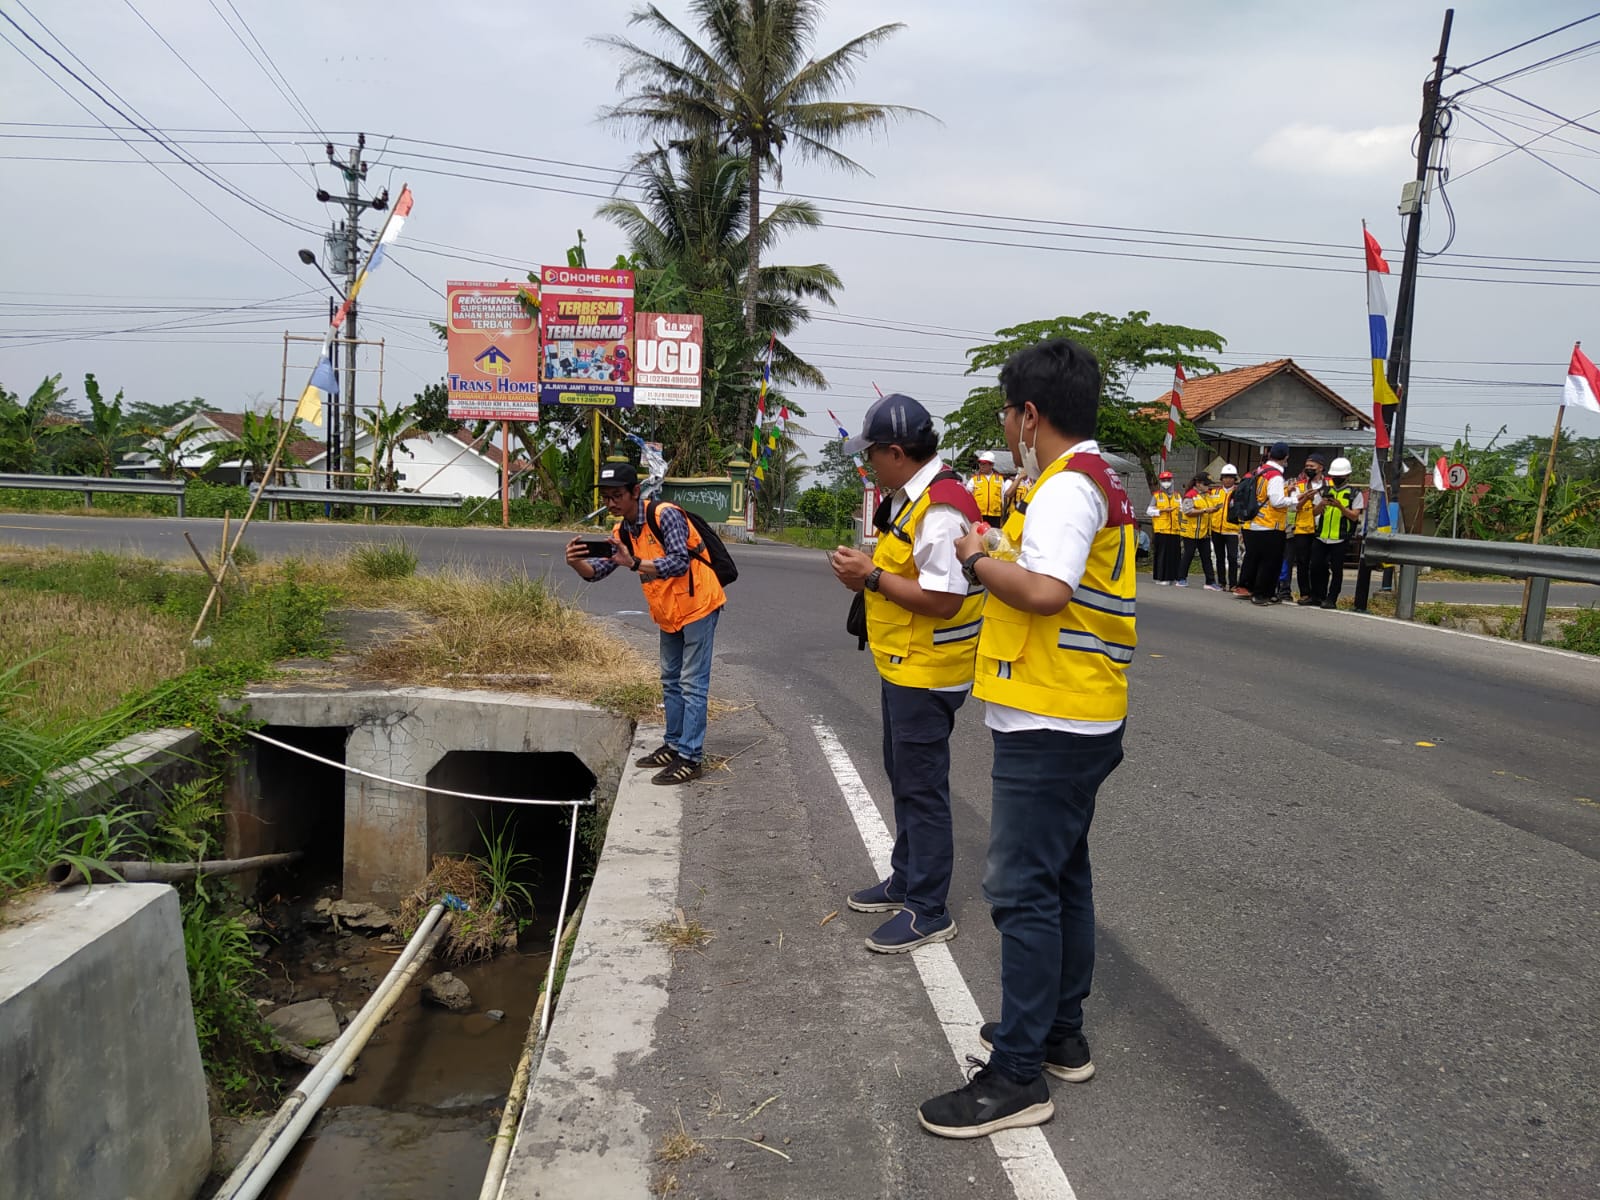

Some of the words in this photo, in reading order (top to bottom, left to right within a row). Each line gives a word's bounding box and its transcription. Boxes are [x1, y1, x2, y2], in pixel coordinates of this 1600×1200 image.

[458, 296, 521, 305] REKOMENDA
[558, 301, 623, 315] TERBESAR
[484, 312, 530, 320] BANGUNAN
[578, 315, 599, 325] DAN
[471, 320, 513, 329] TERBAIK
[679, 323, 693, 331] KM
[546, 325, 627, 340] TERLENGKAP
[636, 339, 700, 374] UGD
